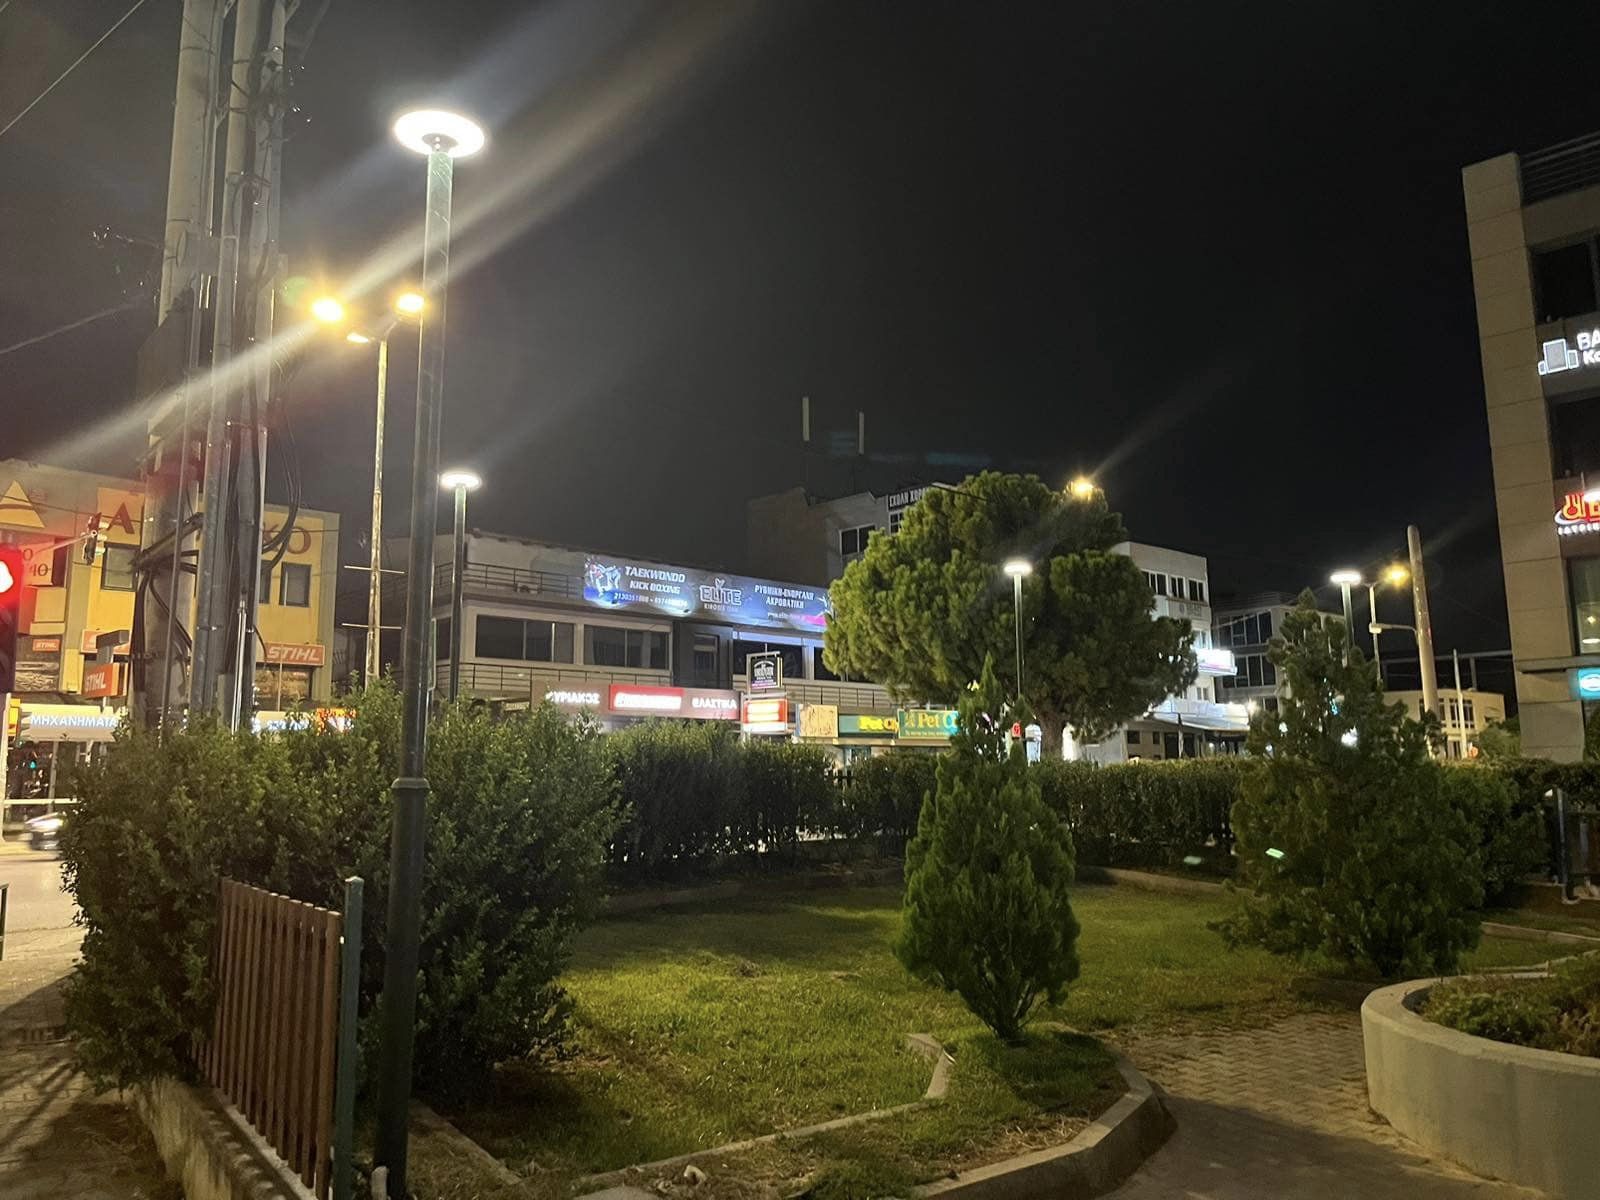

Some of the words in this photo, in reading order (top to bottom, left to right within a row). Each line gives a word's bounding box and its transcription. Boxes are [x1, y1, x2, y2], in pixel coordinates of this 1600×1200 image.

[625, 566, 686, 583] TAEKWONDO
[629, 580, 649, 591] KICK
[650, 582, 681, 594] BOXING
[268, 646, 320, 661] STIHL
[85, 672, 107, 692] STIHL
[918, 712, 939, 729] Pet
